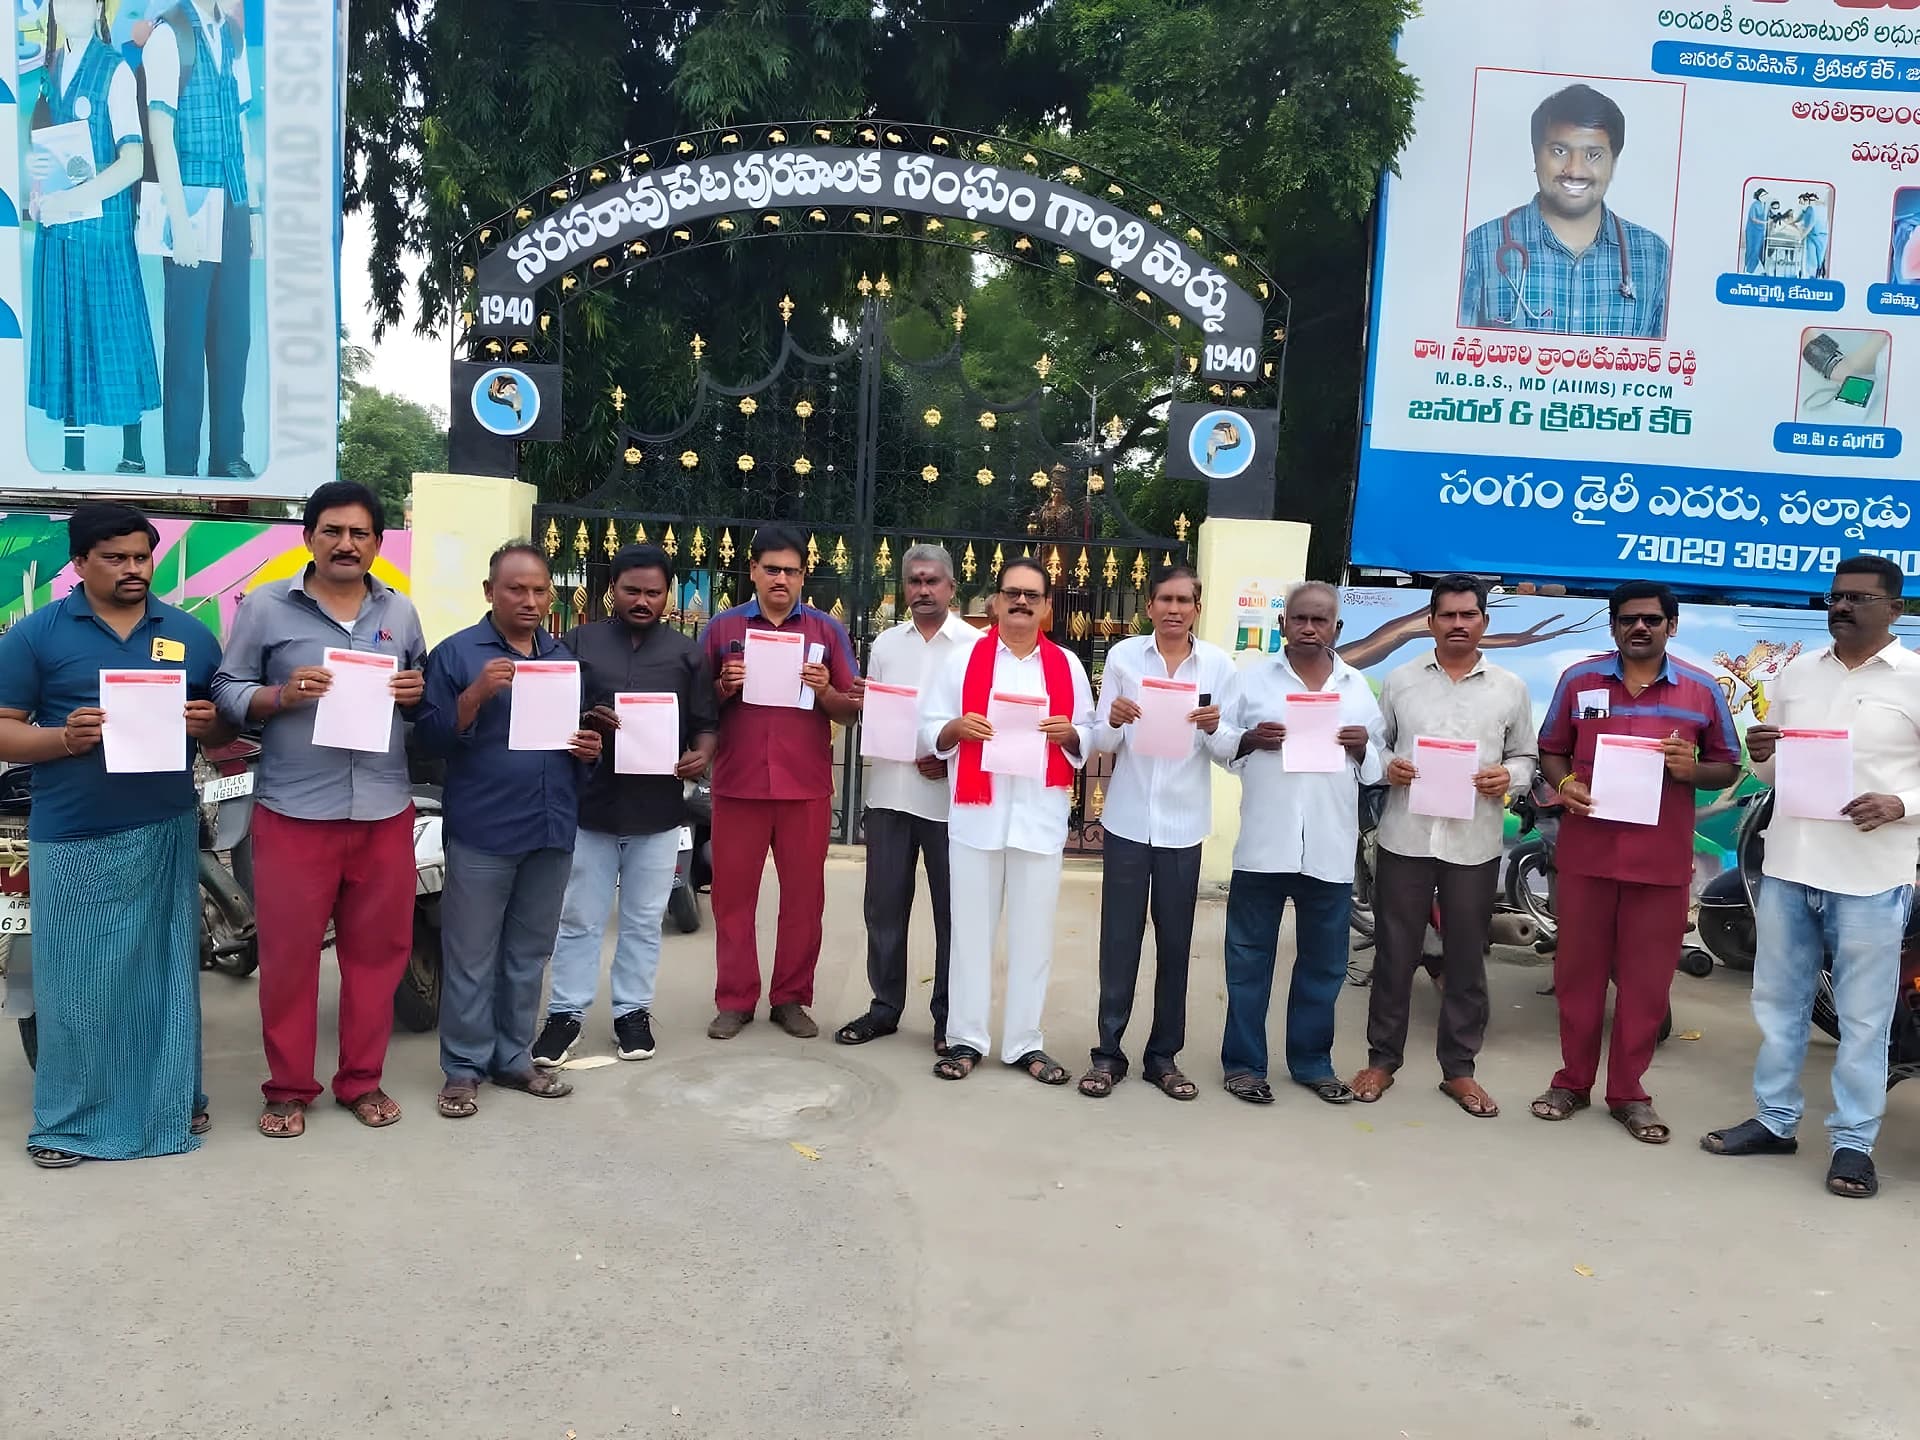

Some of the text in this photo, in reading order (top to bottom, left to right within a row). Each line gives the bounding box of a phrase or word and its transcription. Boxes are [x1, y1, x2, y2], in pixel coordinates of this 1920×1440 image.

[1658, 5, 1734, 33] అందరికీ
[1739, 17, 1869, 42] అందుబాటులో
[733, 151, 882, 208] పురపాలక
[894, 154, 1037, 220] సంఘం
[273, 0, 327, 460] VIT OLYMPIAD SCH
[480, 295, 534, 326] 1940
[1205, 343, 1257, 374] 1940
[1435, 371, 1673, 399] M.B.B.S., MD (AIIMS) FCCM
[1408, 397, 1693, 435] జనరల్ & క్రిటికల్ కేర్
[1439, 469, 1565, 507] సంగం
[1572, 472, 1640, 526] డైరీ
[1778, 491, 1912, 540] పల్నాడు
[1616, 533, 1726, 568] 73029
[1733, 542, 1841, 573] 38979
